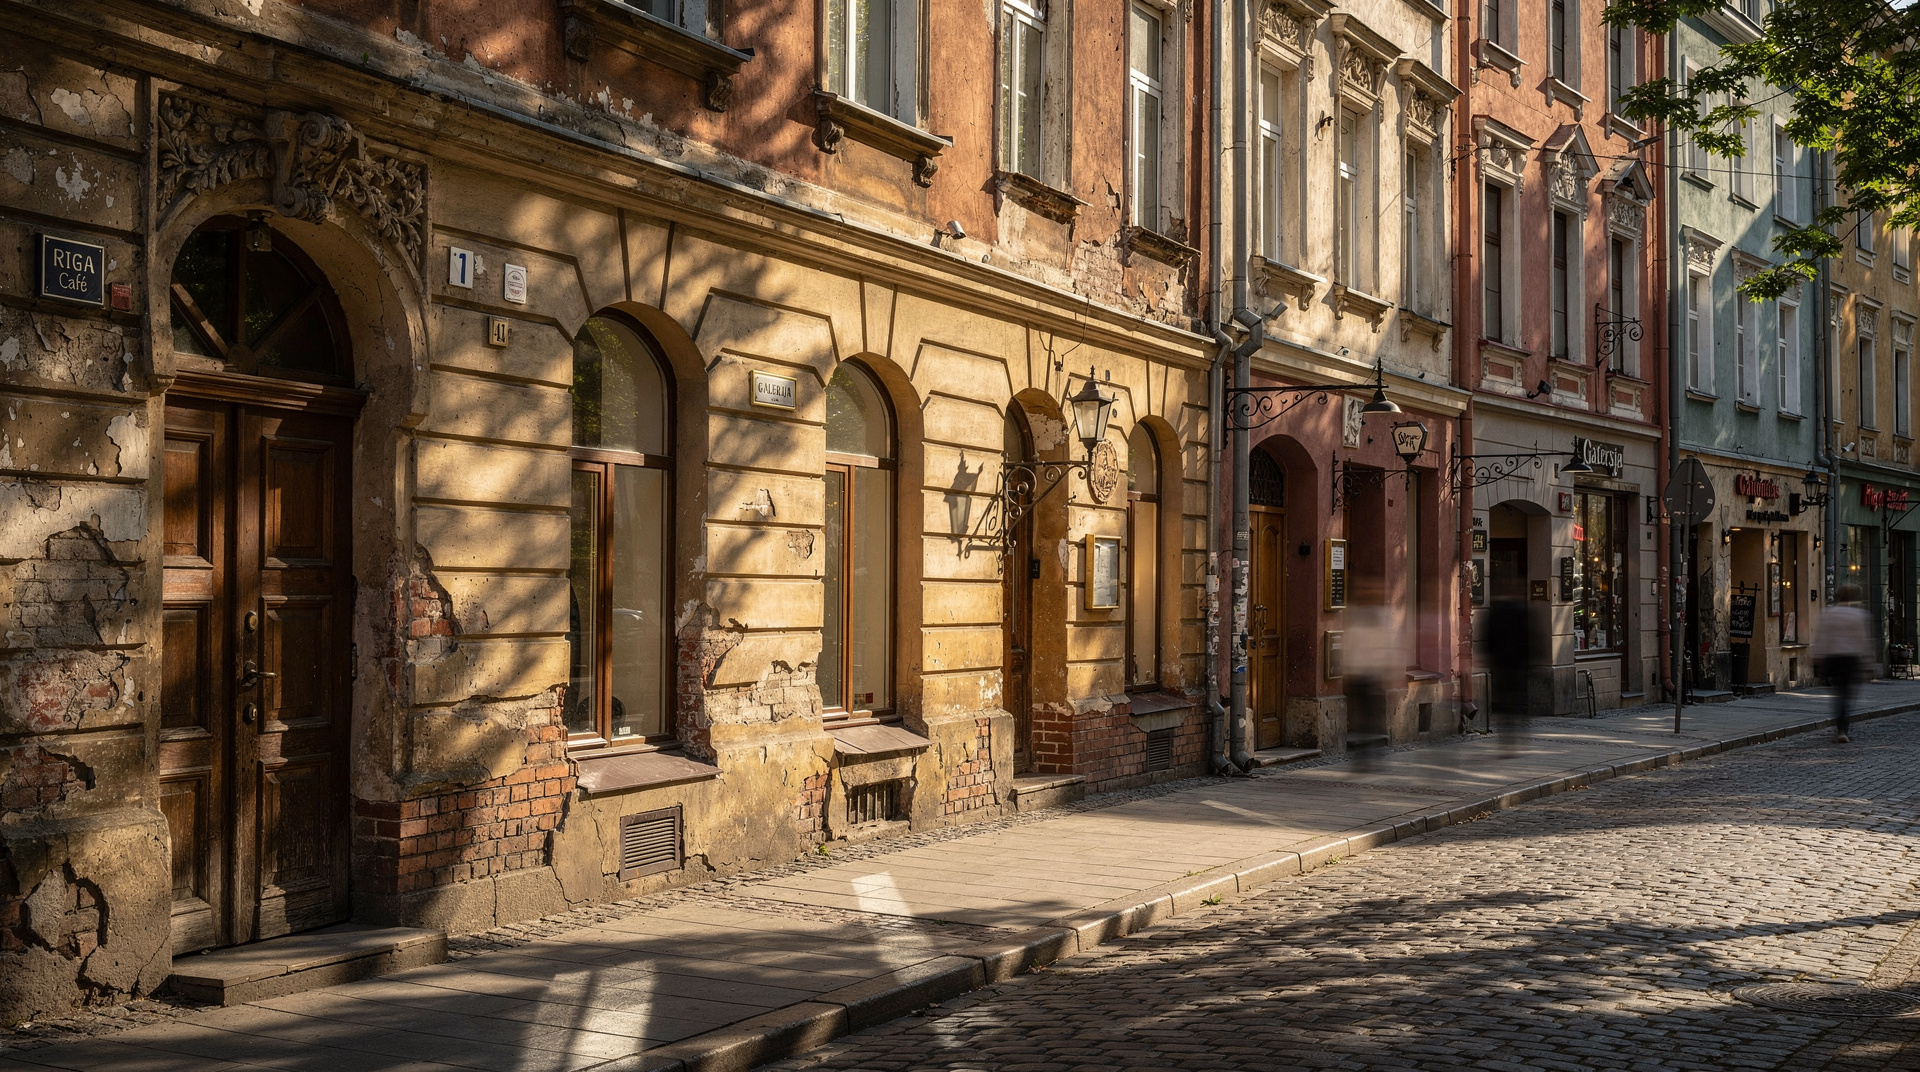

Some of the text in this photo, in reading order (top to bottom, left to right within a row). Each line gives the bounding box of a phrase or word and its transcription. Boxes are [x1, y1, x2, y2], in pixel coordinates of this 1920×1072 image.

[53, 248, 95, 275] RIGA
[459, 253, 466, 284] 1
[59, 272, 88, 293] Café
